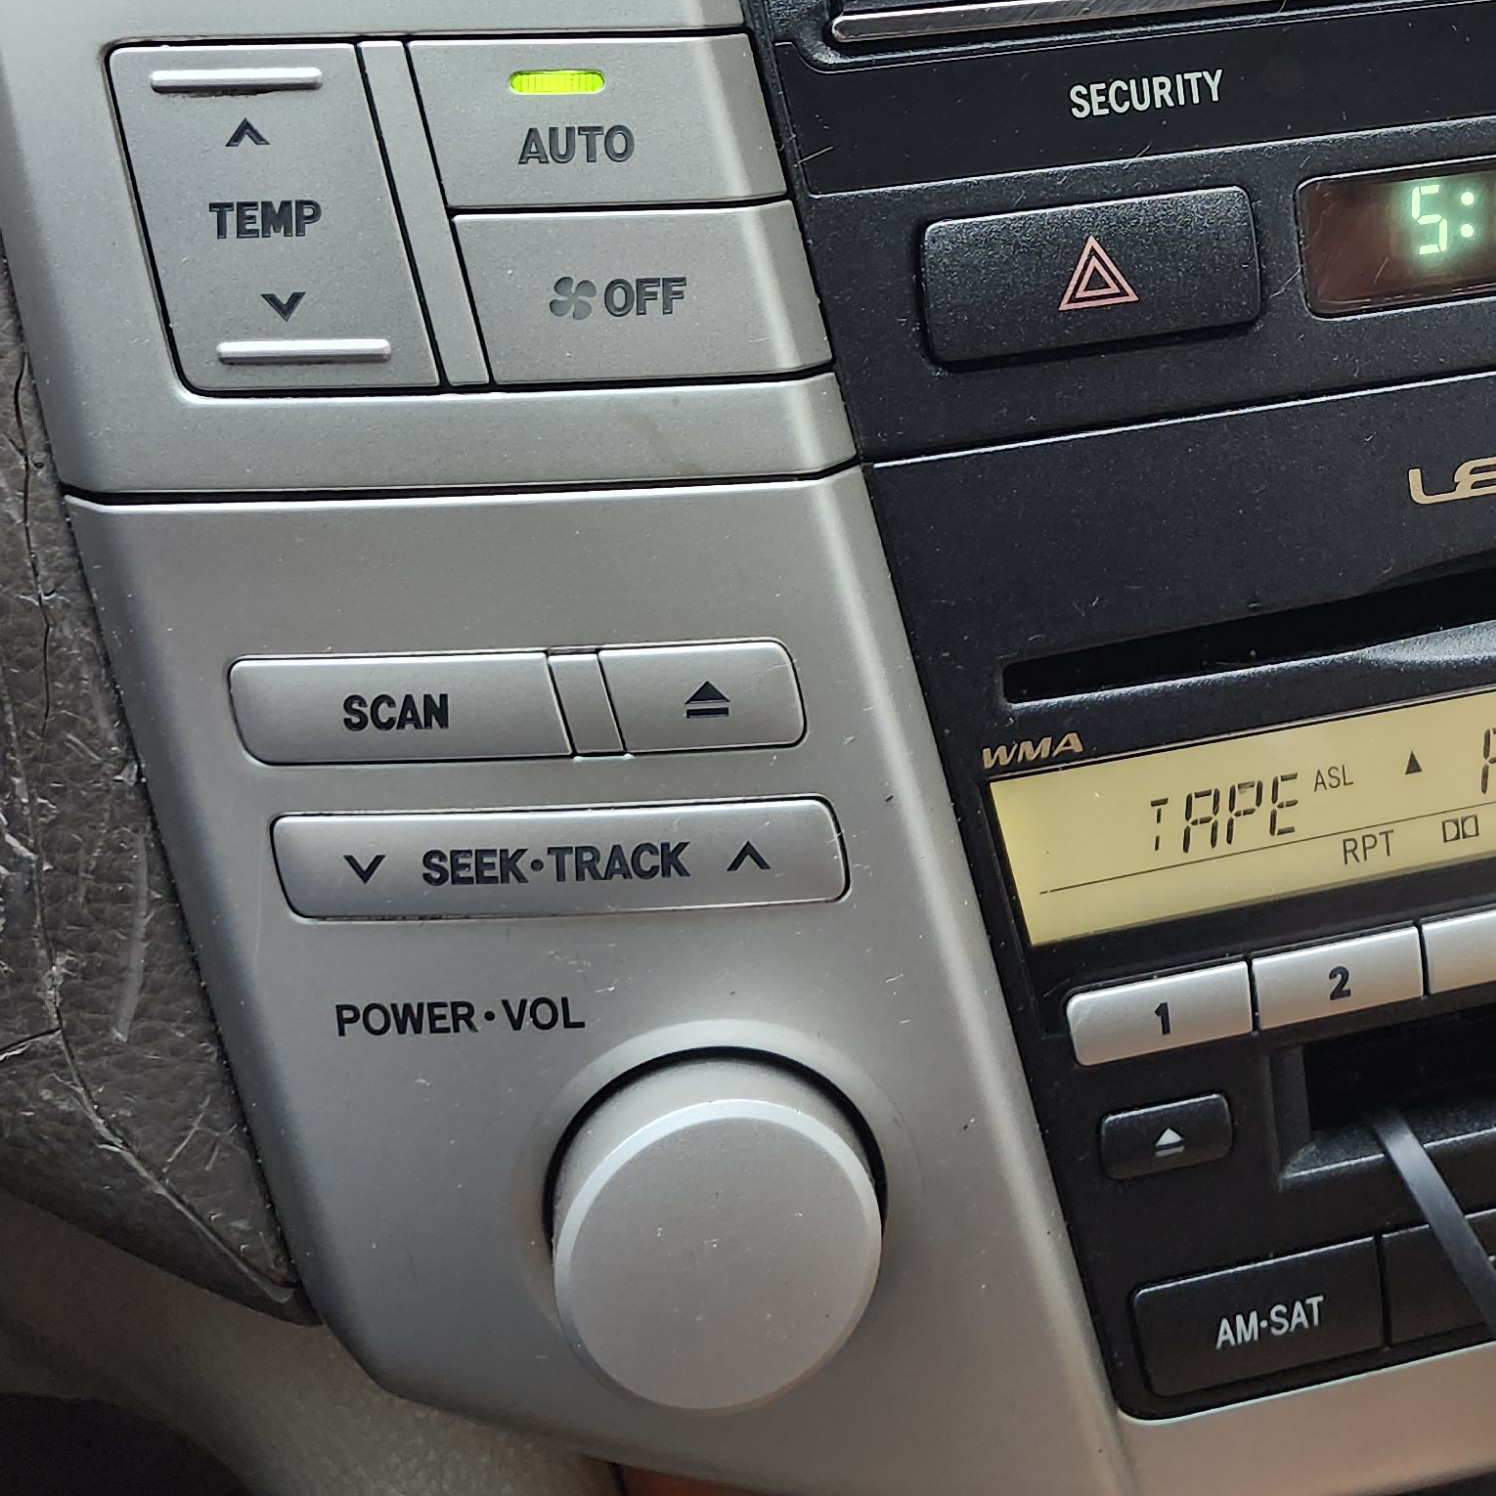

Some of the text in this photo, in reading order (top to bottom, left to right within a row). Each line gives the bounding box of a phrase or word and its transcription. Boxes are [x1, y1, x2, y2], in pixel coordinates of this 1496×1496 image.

[1069, 68, 1225, 119] SECURITY
[517, 124, 635, 165] AUTO
[208, 199, 323, 239] TEMP
[602, 276, 688, 318] OFF
[342, 693, 450, 732] SCAN
[981, 731, 1085, 770] WMA
[1149, 771, 1299, 854] TAPE
[1313, 764, 1355, 793] ASL
[1342, 828, 1396, 866] RPT
[1327, 966, 1352, 1001] 2
[1153, 1001, 1171, 1035] 1
